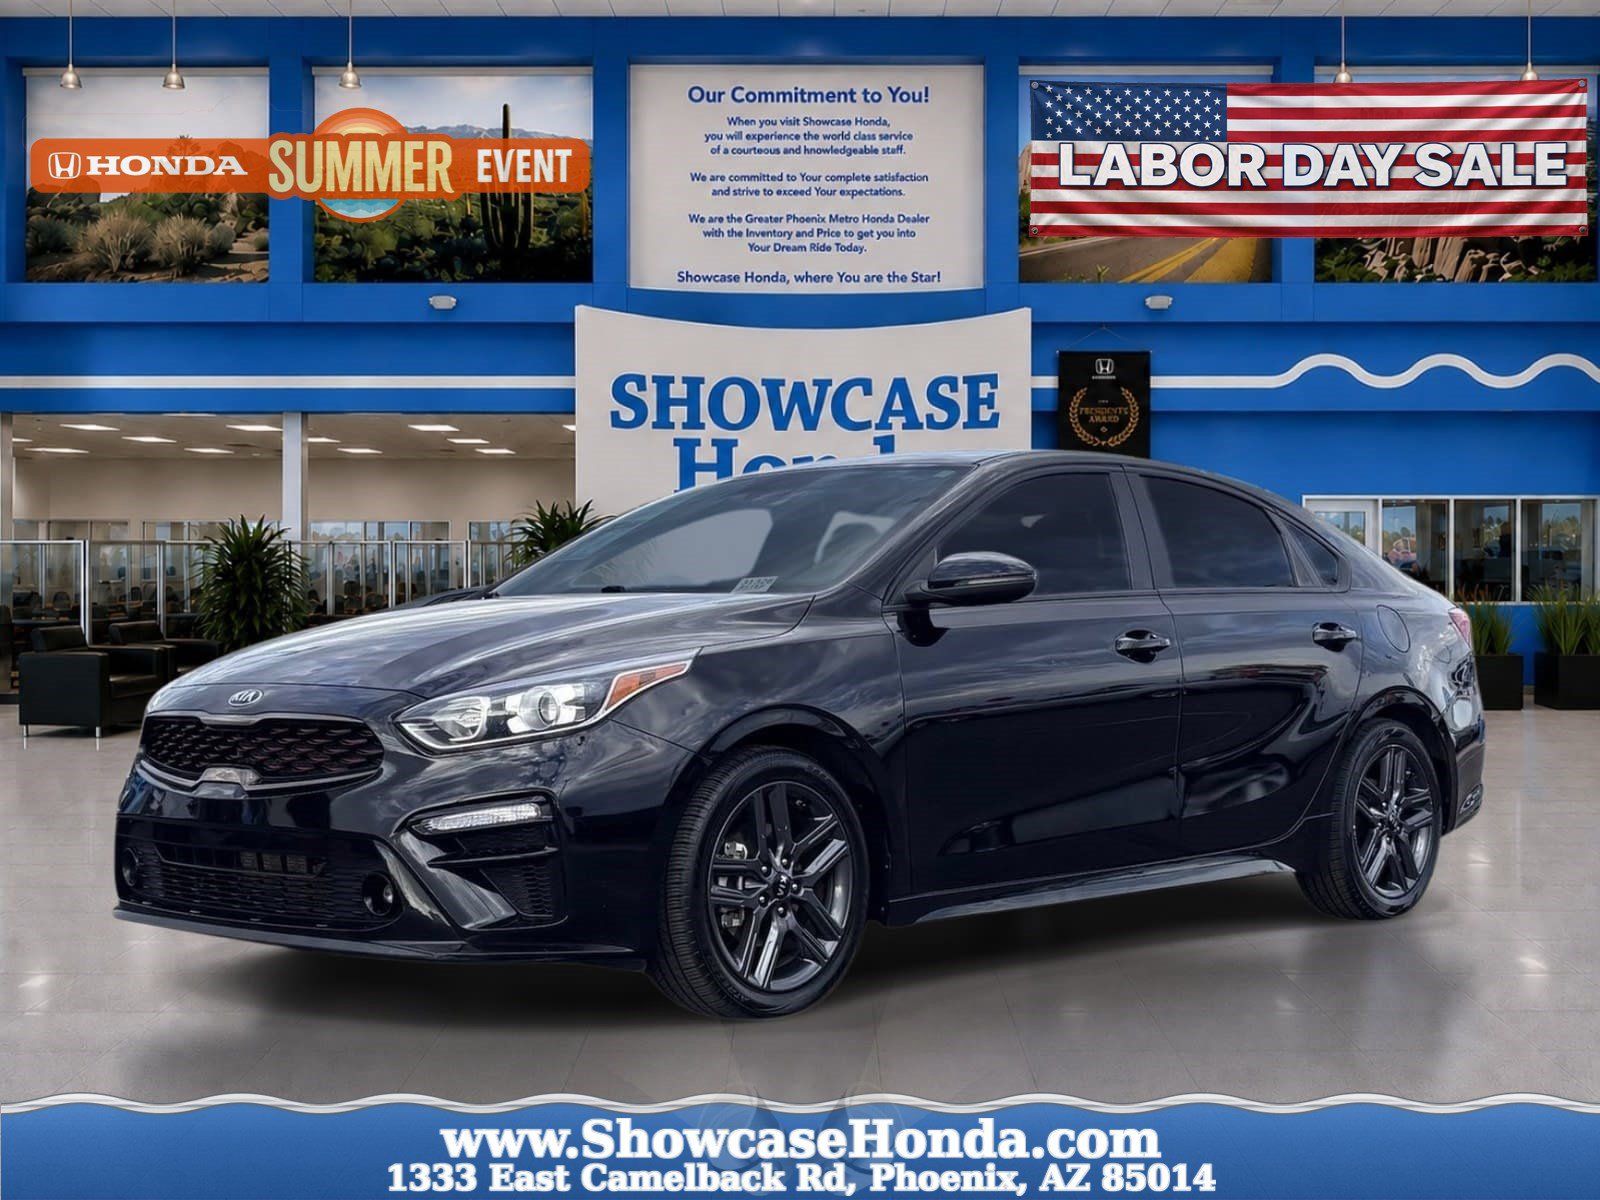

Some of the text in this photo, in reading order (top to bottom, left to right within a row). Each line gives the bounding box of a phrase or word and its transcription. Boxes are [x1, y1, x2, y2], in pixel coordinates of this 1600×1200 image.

[688, 86, 929, 103] Our Commitment to You!
[727, 117, 890, 128] When you visit Showcase Honda,
[705, 131, 913, 143] you will experience the world class service
[710, 145, 720, 154] of
[731, 147, 781, 155] courteous
[783, 145, 801, 154] and
[882, 144, 905, 154] staff.
[1058, 143, 1568, 187] LABOR DAY SALE
[690, 173, 707, 182] We
[729, 172, 783, 182] committed
[800, 173, 822, 182] Your
[825, 172, 871, 184] complete
[874, 172, 928, 182] satisfaction
[712, 187, 905, 199] and strive to exceed Your expectations.
[689, 214, 705, 223] We
[726, 214, 742, 223] the
[745, 214, 783, 223] Greater
[786, 214, 825, 223] Phoenix
[829, 214, 859, 223] Metro
[862, 214, 894, 223] Honda
[898, 214, 930, 223] Dealer
[703, 228, 724, 237] with
[727, 228, 743, 237] the
[746, 228, 793, 240] Inventory
[796, 228, 814, 237] and
[817, 228, 841, 237] Price
[857, 230, 874, 240] get
[877, 231, 894, 240] you
[897, 228, 916, 237] into
[748, 243, 867, 254] Your Dream Ride Today.
[677, 271, 940, 284] Showcase Honda, where You are the Star!
[610, 373, 1000, 431] SHOWCASE
[229, 689, 262, 706] KIA
